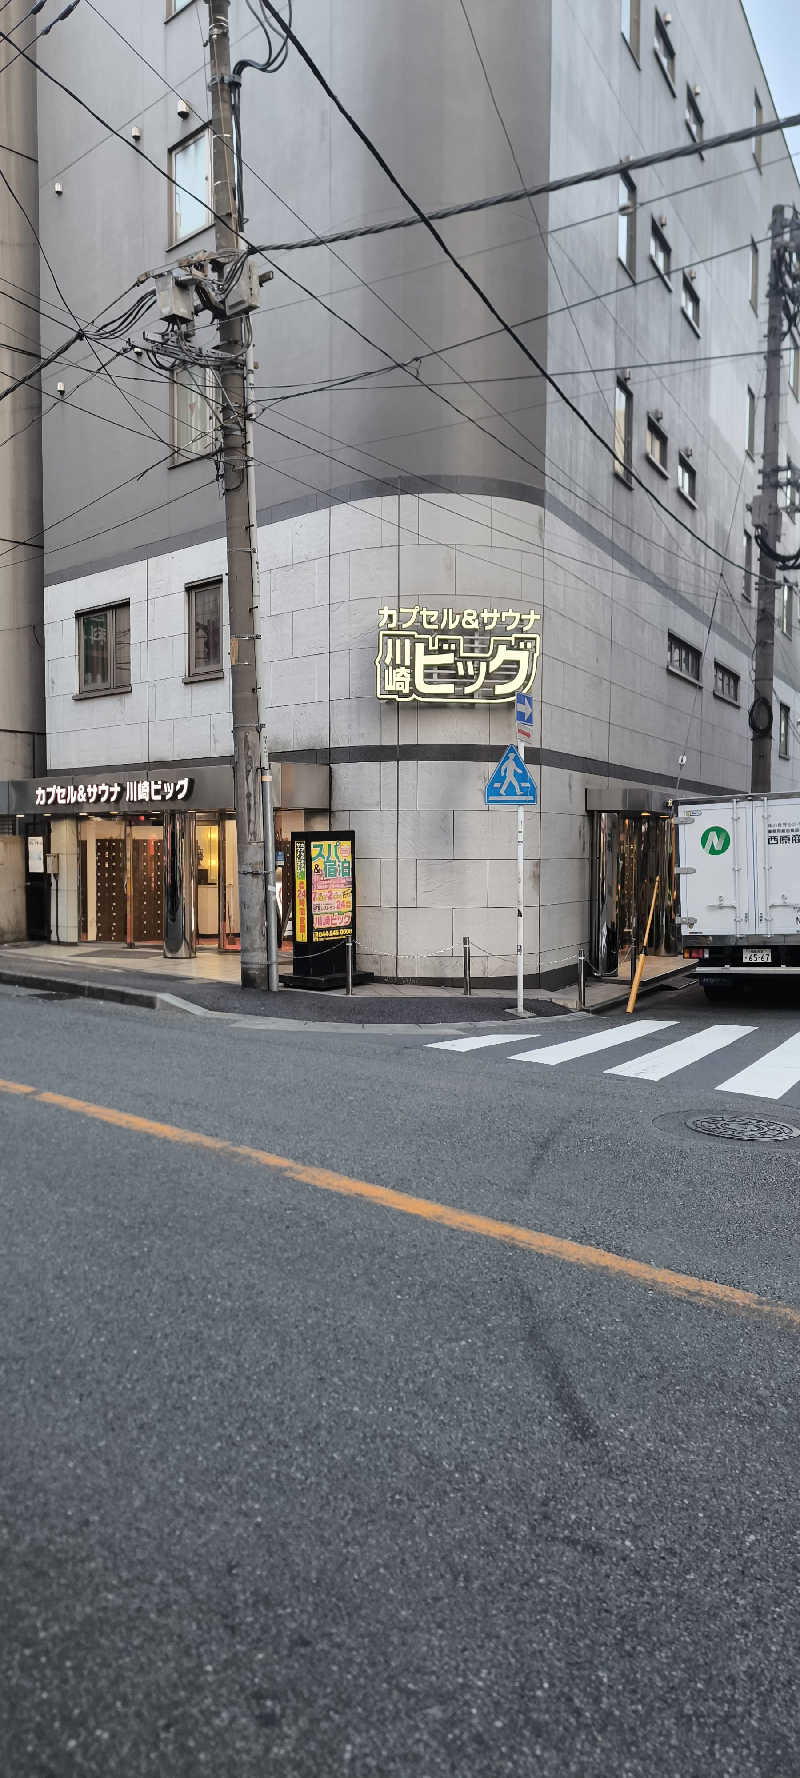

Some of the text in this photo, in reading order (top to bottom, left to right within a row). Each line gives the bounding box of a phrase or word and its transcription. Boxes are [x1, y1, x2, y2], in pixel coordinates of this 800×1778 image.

[378, 606, 540, 632] カプセル&サウナ
[35, 778, 189, 805] カプセル&サウナ 川崎ビッグ
